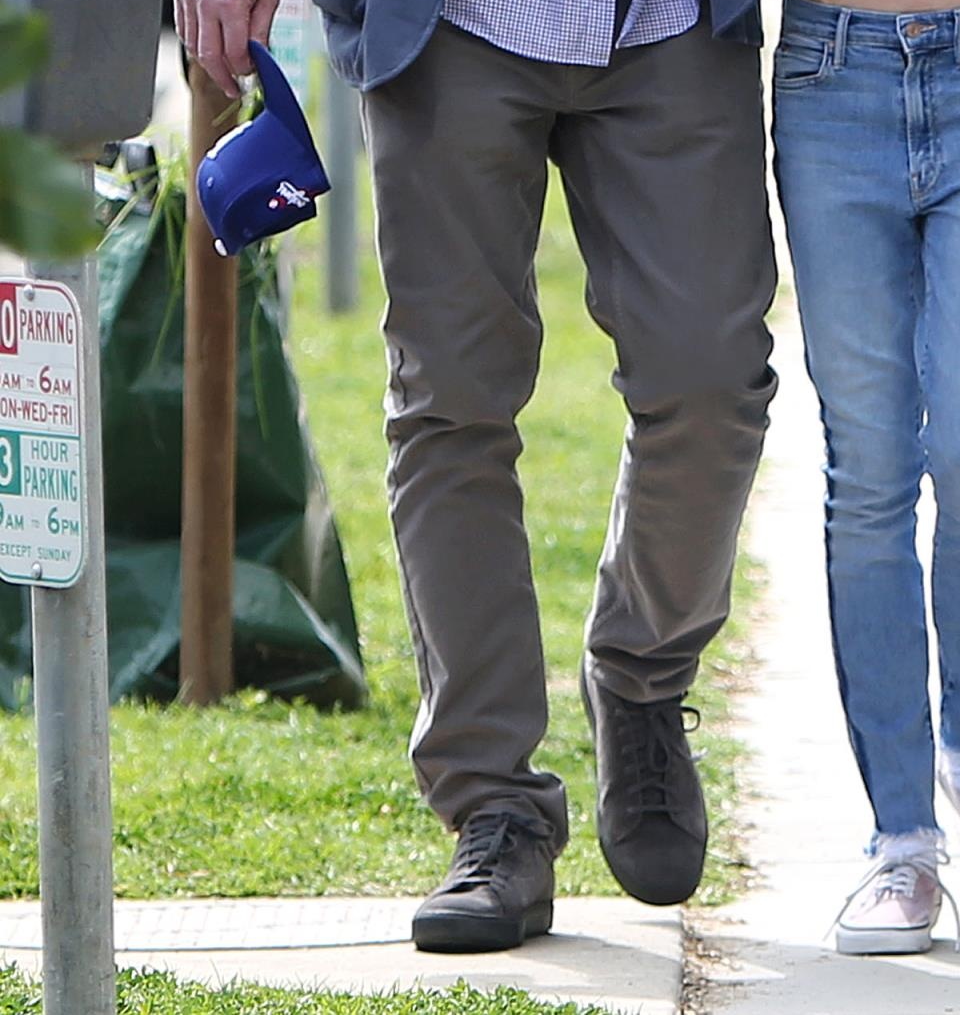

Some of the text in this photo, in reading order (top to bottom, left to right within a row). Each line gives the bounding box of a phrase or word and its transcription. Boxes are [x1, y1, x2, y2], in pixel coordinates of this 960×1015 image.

[20, 308, 73, 345] PARKING
[0, 373, 20, 390] AM
[39, 365, 71, 395] 6AM
[31, 440, 68, 462] HOUR
[24, 466, 77, 502] PARKING
[48, 507, 79, 536] 6PM
[0, 543, 71, 562] EXCEPT SUNDAY
